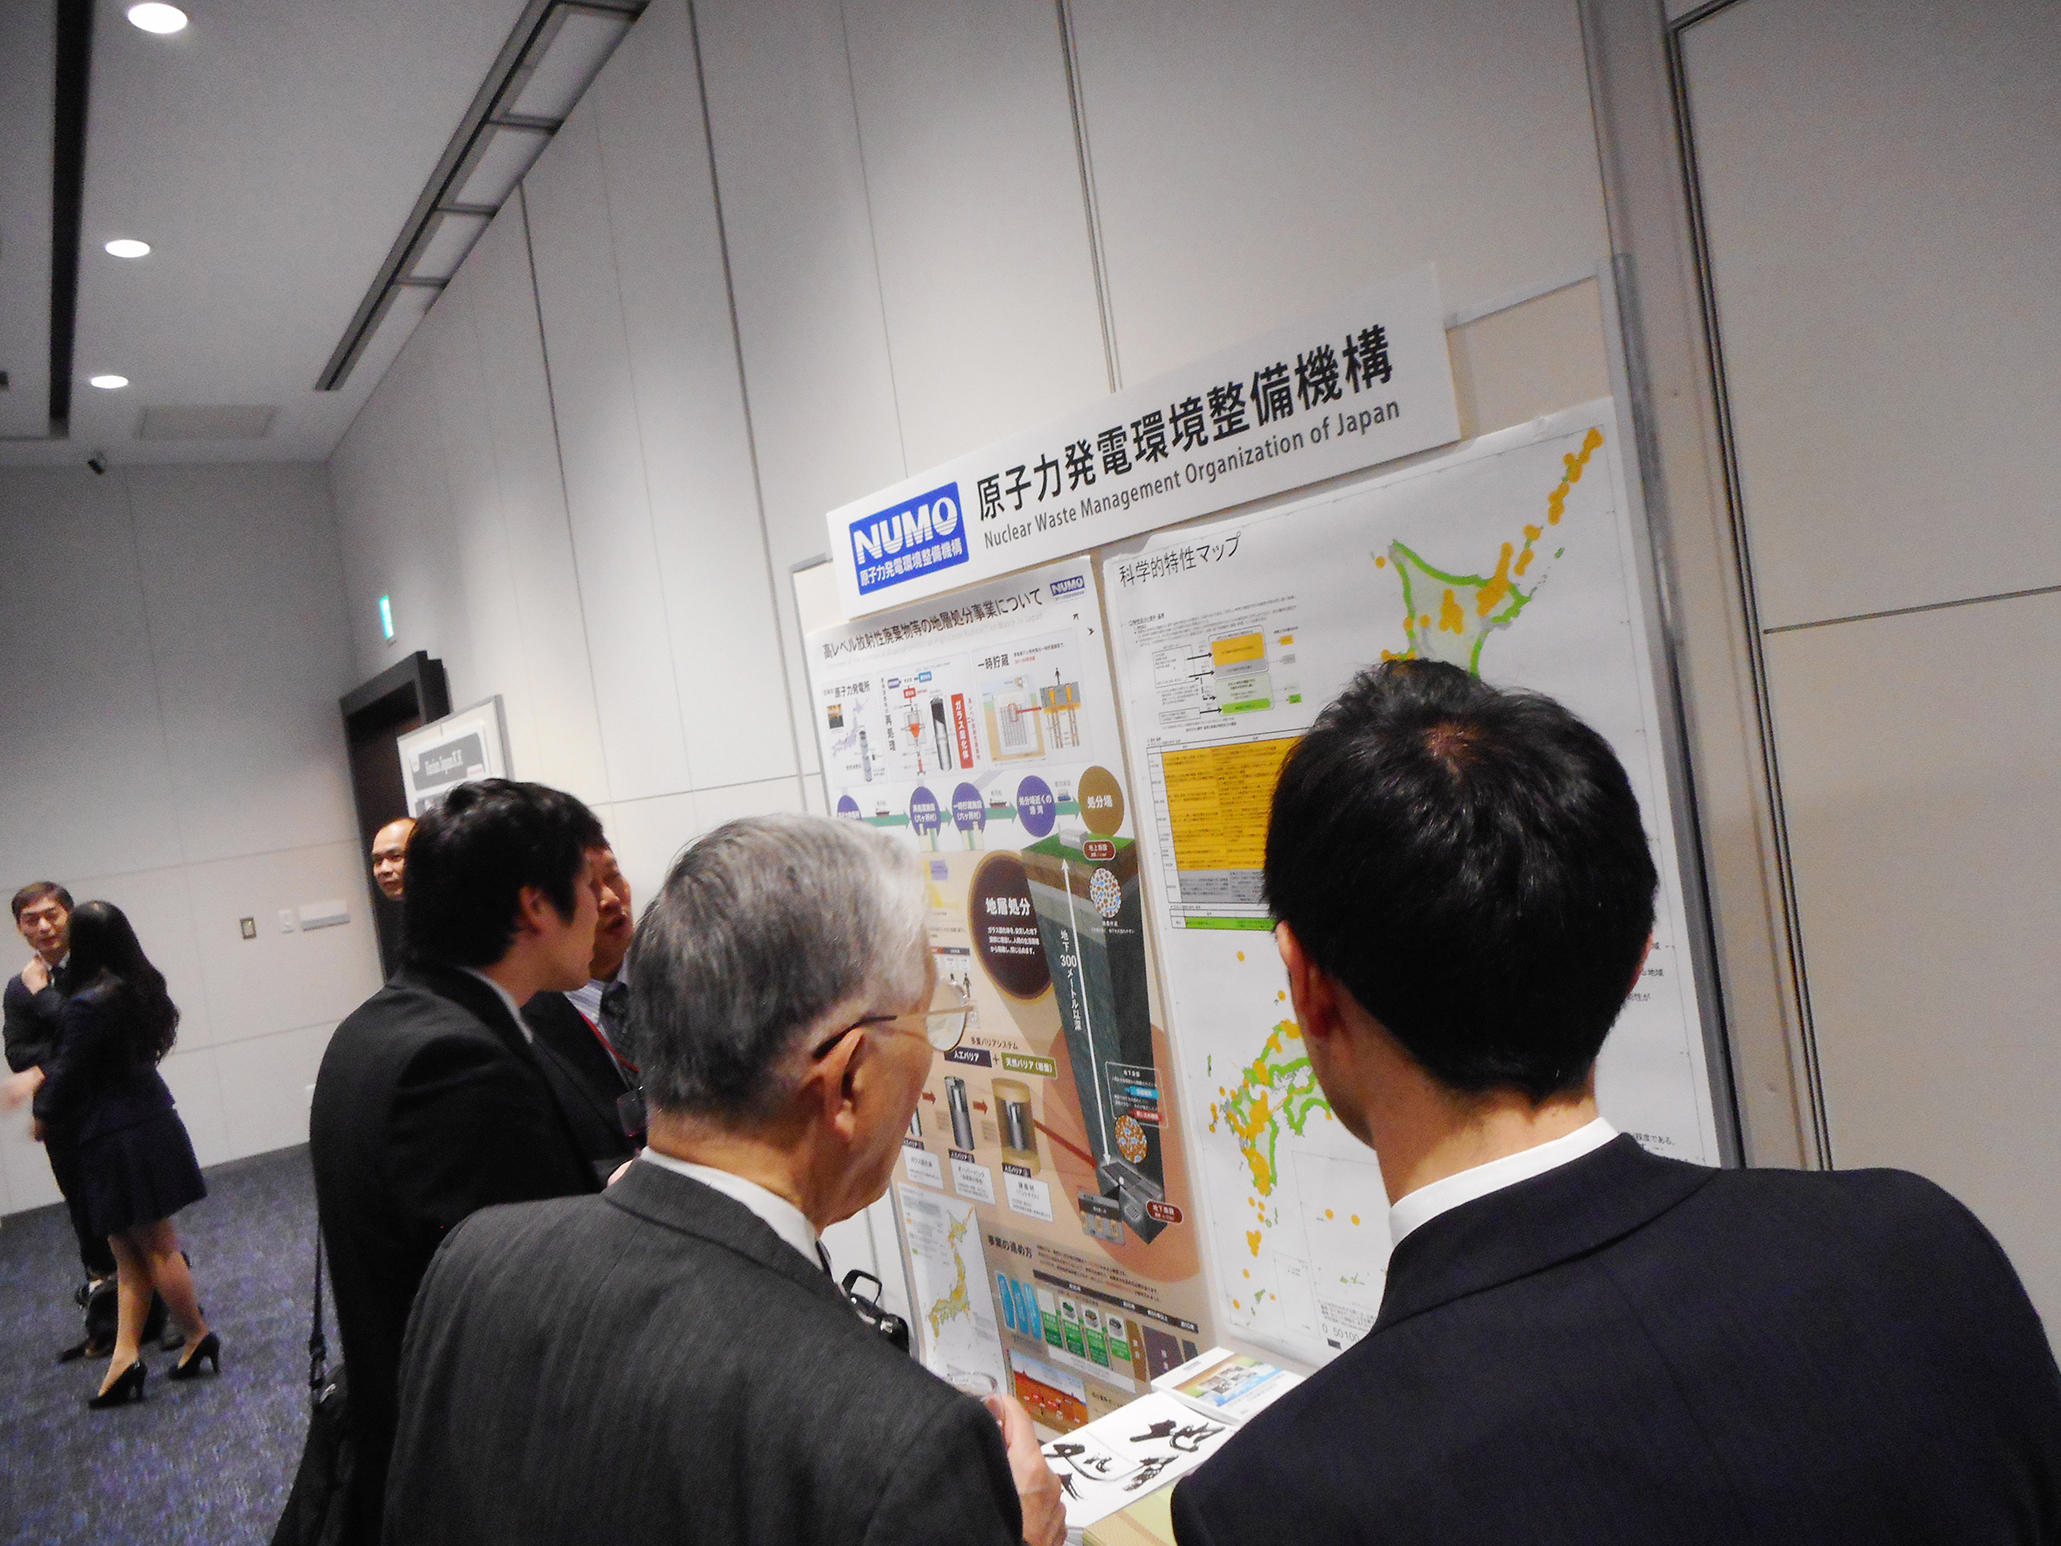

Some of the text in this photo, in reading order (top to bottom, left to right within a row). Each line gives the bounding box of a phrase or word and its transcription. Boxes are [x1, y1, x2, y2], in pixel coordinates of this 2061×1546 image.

[977, 324, 1393, 521] 原子力発電環境整備機構
[984, 401, 1401, 549] Nuclear Waste Management Organization of Japan
[854, 497, 958, 565] NUMO
[1119, 531, 1241, 587] 科学的特性マップ
[860, 538, 963, 587] 原子力発電環境整備機構
[1051, 577, 1083, 595] NUMO
[823, 588, 1043, 659] 高レベル放射性廃棄物等の地層処分事業について
[985, 897, 1031, 916] 地層処分
